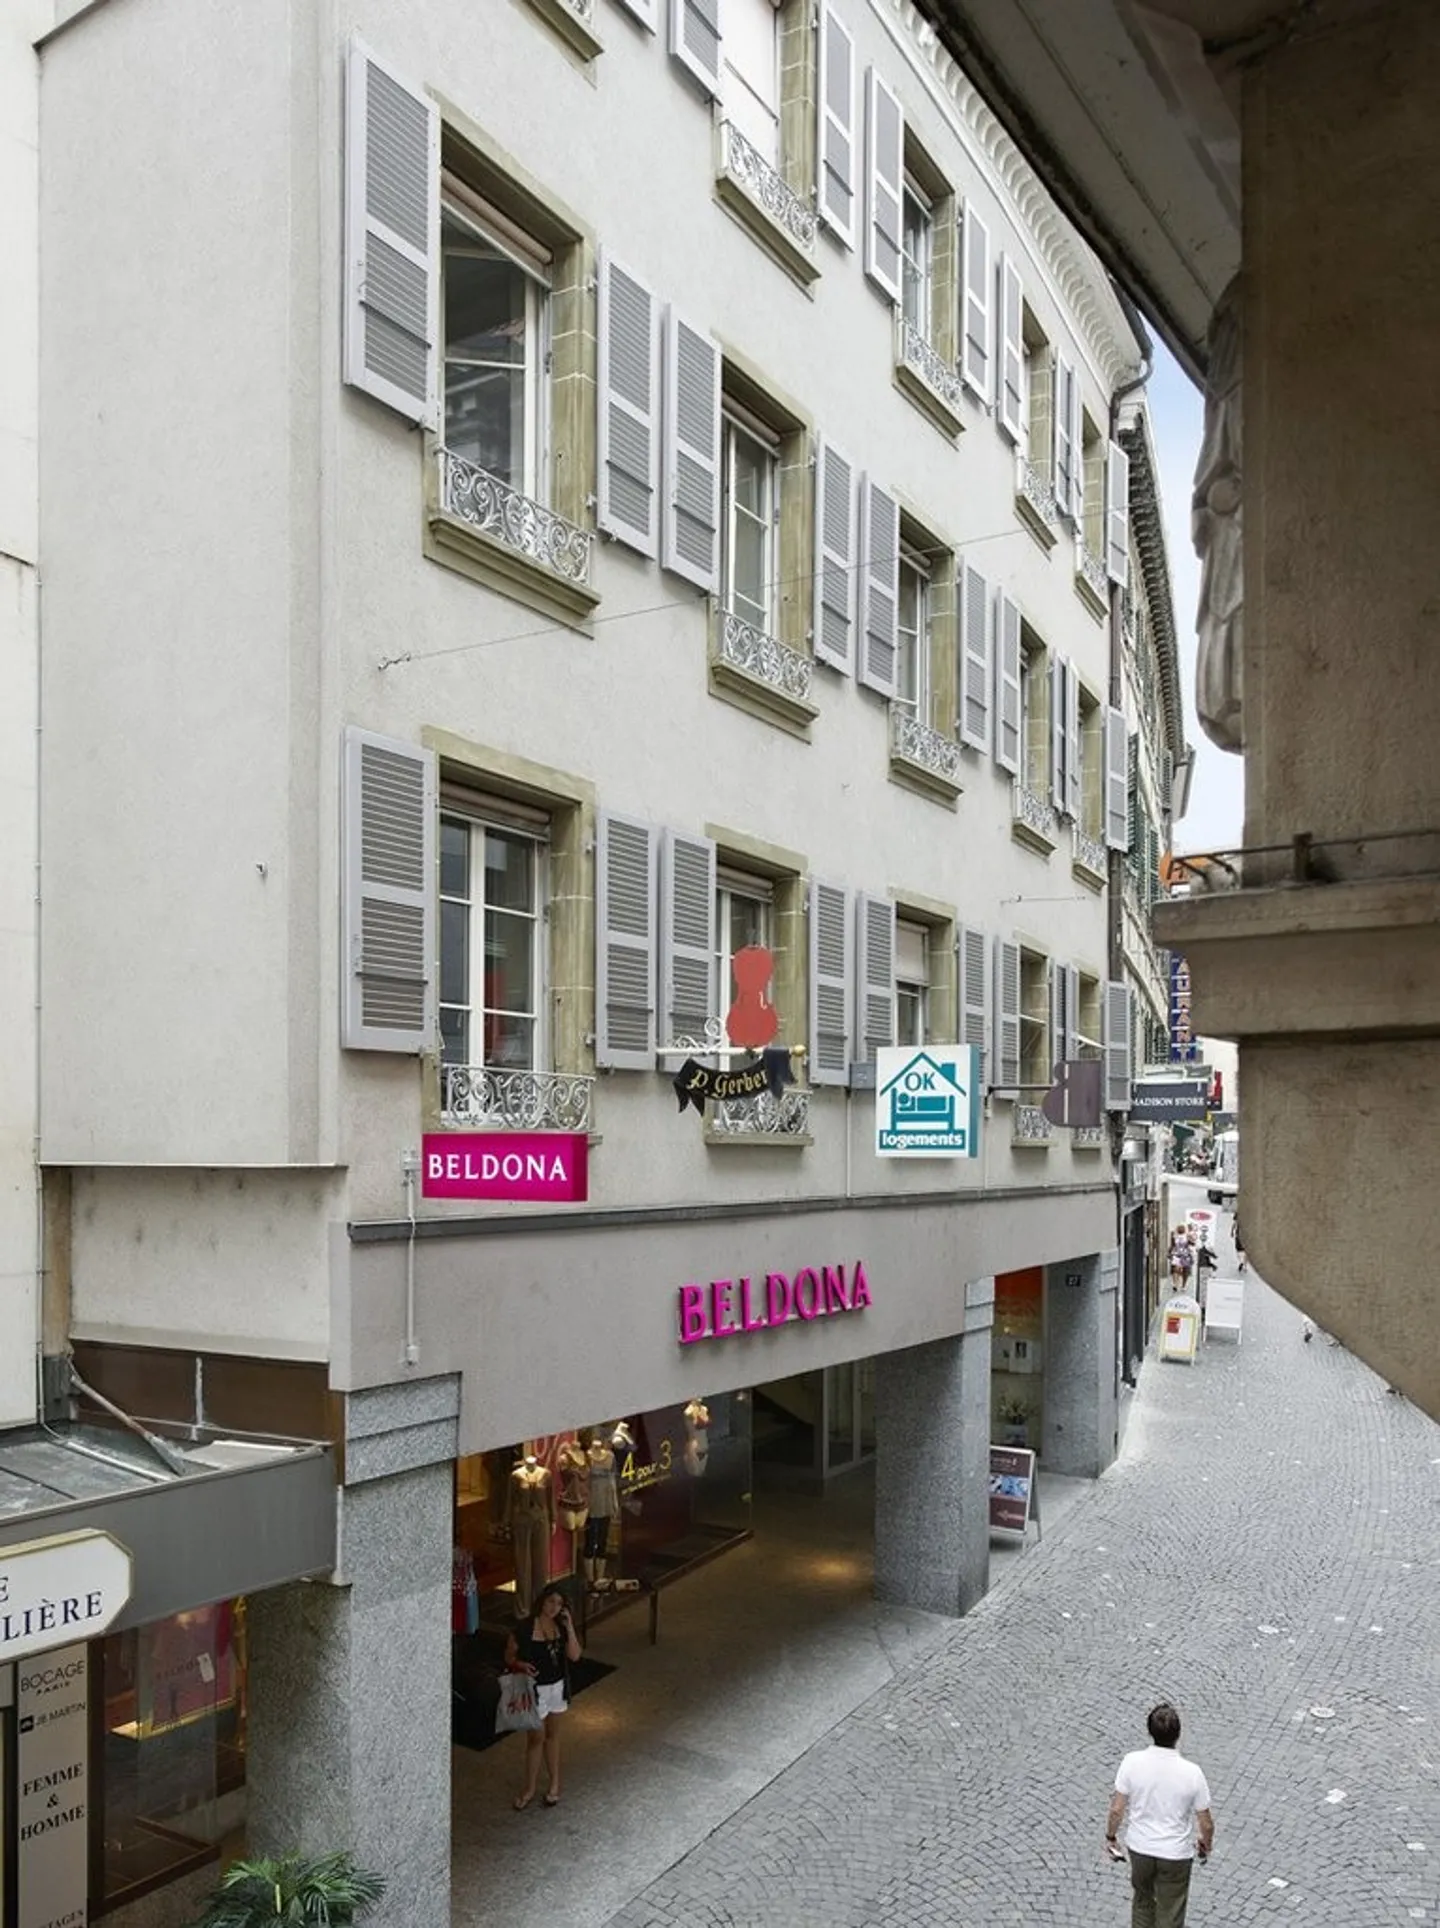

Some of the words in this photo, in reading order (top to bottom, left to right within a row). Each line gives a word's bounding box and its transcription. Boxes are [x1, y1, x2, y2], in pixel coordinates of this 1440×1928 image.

[1176, 958, 1192, 1061] AURANT
[711, 1069, 768, 1099] Gerber
[904, 1072, 936, 1092] OK
[882, 1131, 963, 1150] logements
[428, 1154, 567, 1181] BELDONA
[679, 1260, 872, 1345] BELDONA
[621, 1451, 635, 1481] 4
[660, 1440, 672, 1470] 3
[2, 1591, 102, 1641] LIÈRE
[21, 1660, 85, 1692] BOCAGE
[23, 1762, 84, 1796] FEMME
[46, 1793, 59, 1809] &
[20, 1804, 85, 1841] HOMME
